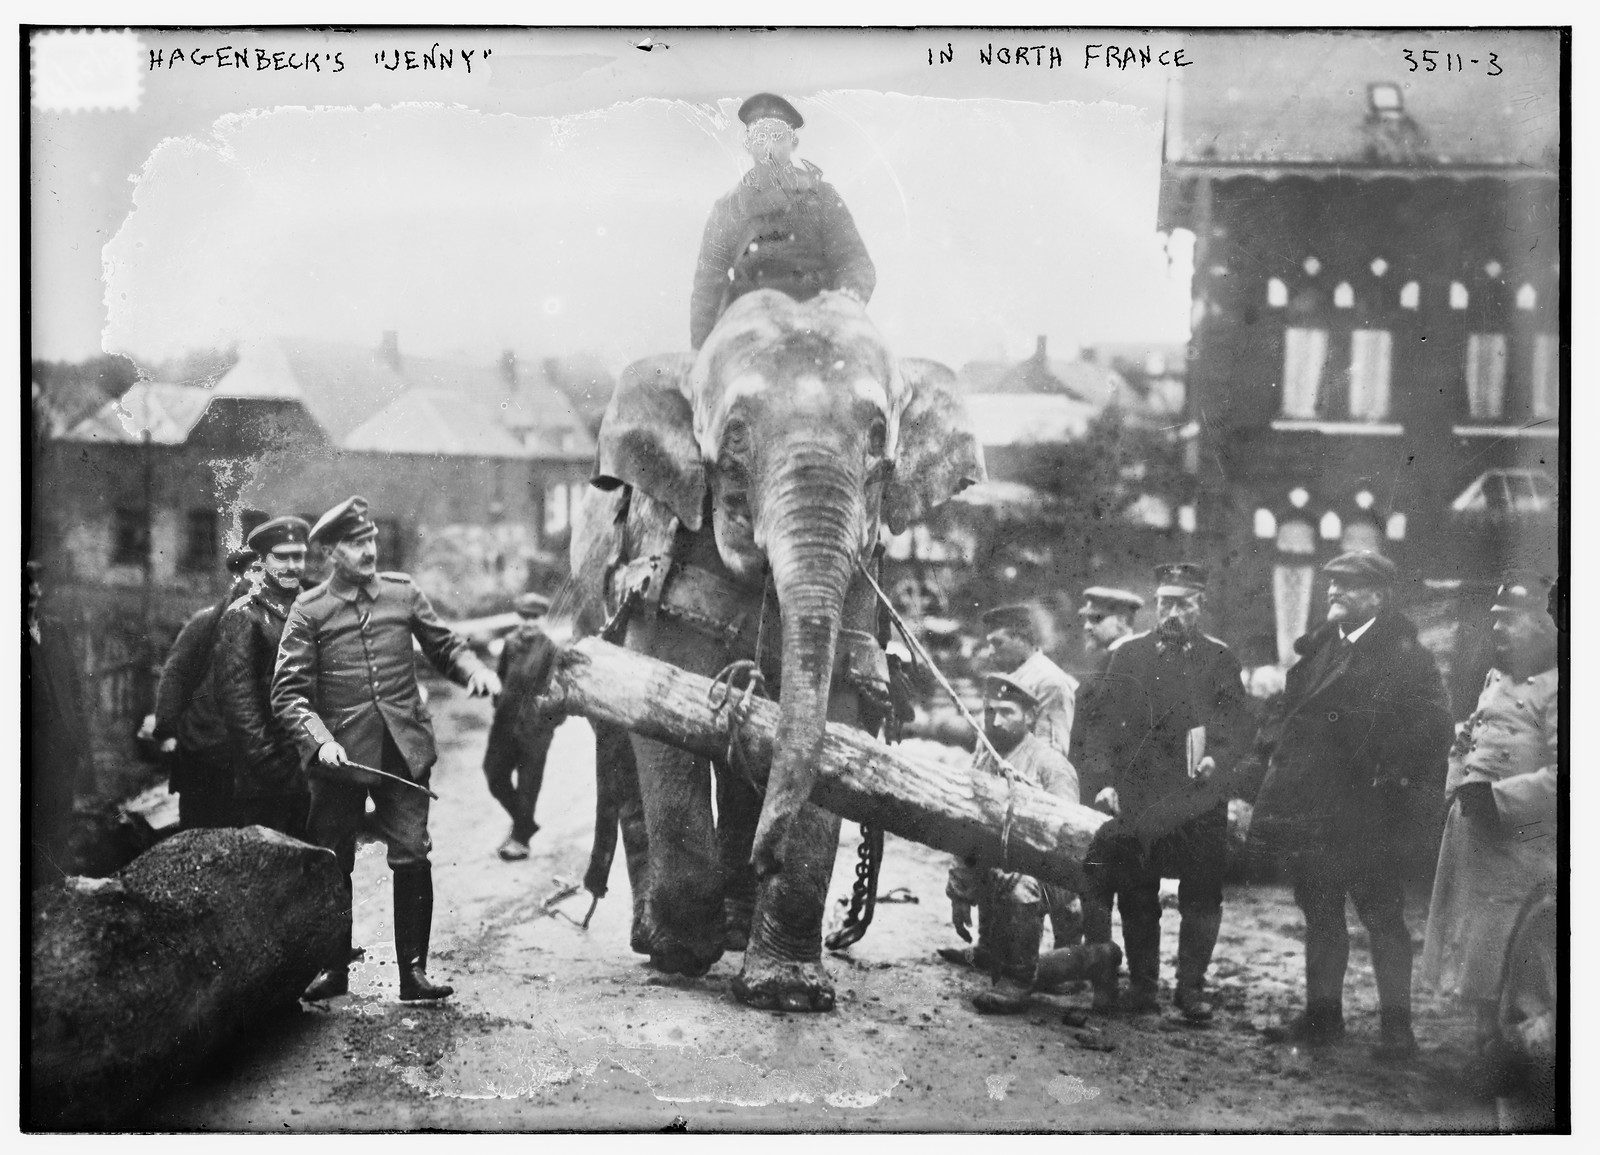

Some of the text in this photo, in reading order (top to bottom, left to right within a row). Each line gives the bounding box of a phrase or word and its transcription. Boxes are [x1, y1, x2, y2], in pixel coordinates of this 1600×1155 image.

[149, 46, 345, 73] HAGENBECK'S
[374, 42, 492, 74] "JENNY"
[927, 43, 1194, 71] IN NORTH FRANCE
[1402, 48, 1504, 76] 3511-3
